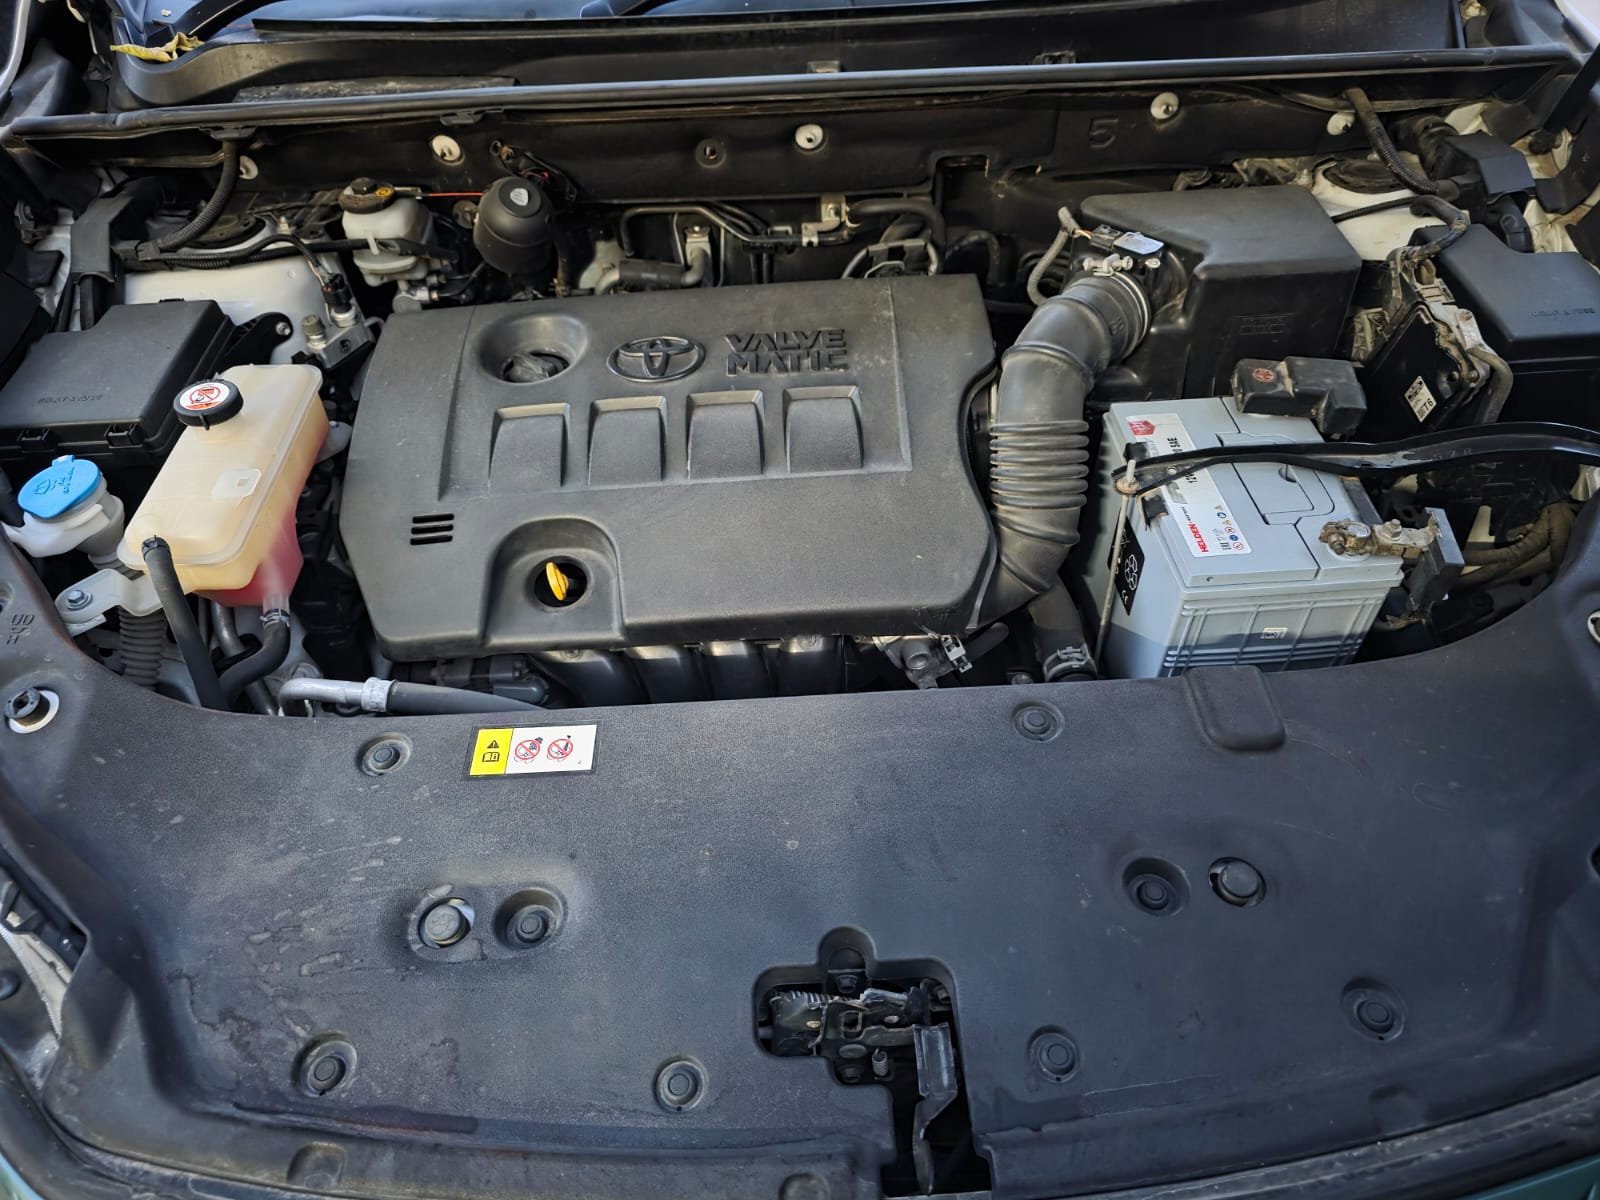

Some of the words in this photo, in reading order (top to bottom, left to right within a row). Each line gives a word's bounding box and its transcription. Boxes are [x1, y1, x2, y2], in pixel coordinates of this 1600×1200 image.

[1088, 115, 1119, 149] 5
[725, 328, 847, 352] VALVE
[726, 350, 848, 376] MATIC
[1188, 523, 1209, 552] HELDEN
